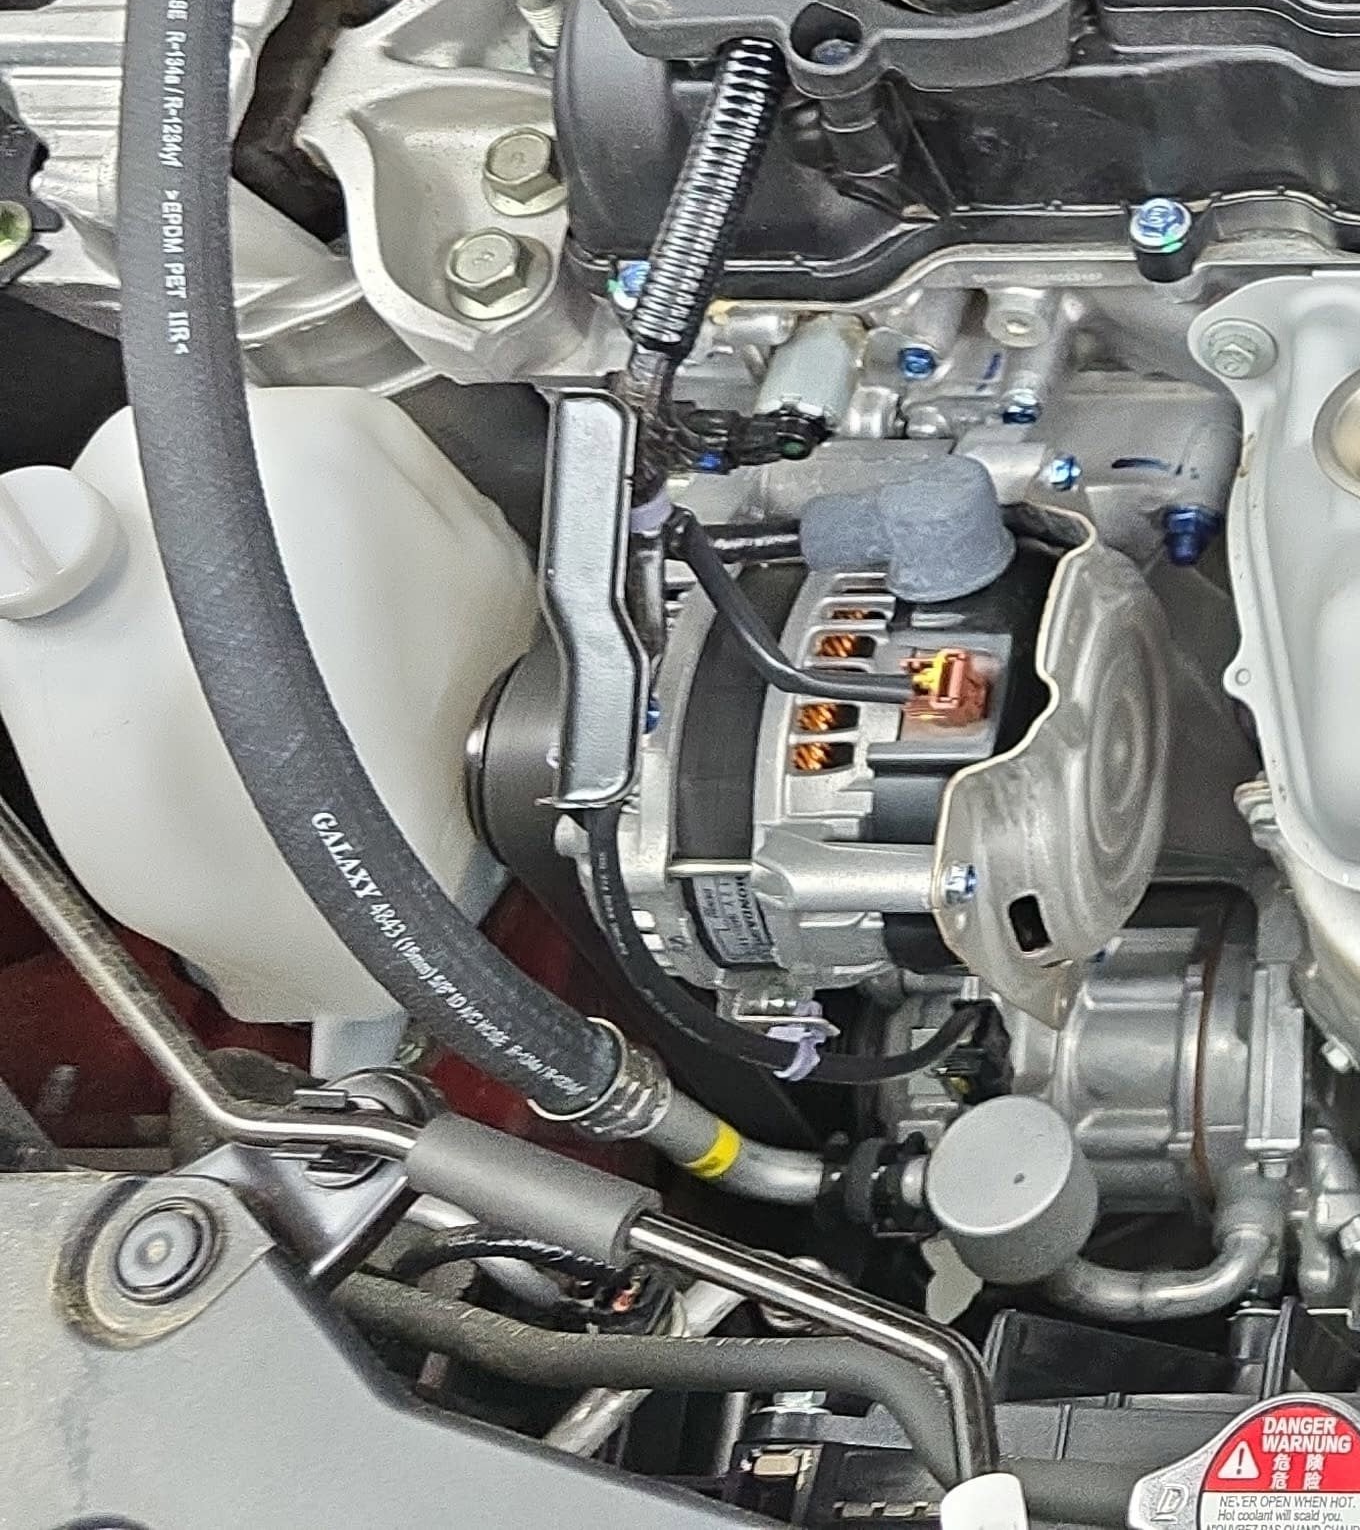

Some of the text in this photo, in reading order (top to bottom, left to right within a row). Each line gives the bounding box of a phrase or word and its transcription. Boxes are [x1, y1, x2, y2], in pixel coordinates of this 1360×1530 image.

[164, 263, 187, 298] PET
[311, 812, 383, 899] GALAXY
[369, 903, 406, 939] 4843
[1263, 1416, 1337, 1435] DANGER
[1262, 1434, 1353, 1453] WARNUNG
[1219, 1496, 1356, 1508] NEVER OPEN WHEN HOT.
[1217, 1509, 1343, 1524] Hot coolant will scald you.
